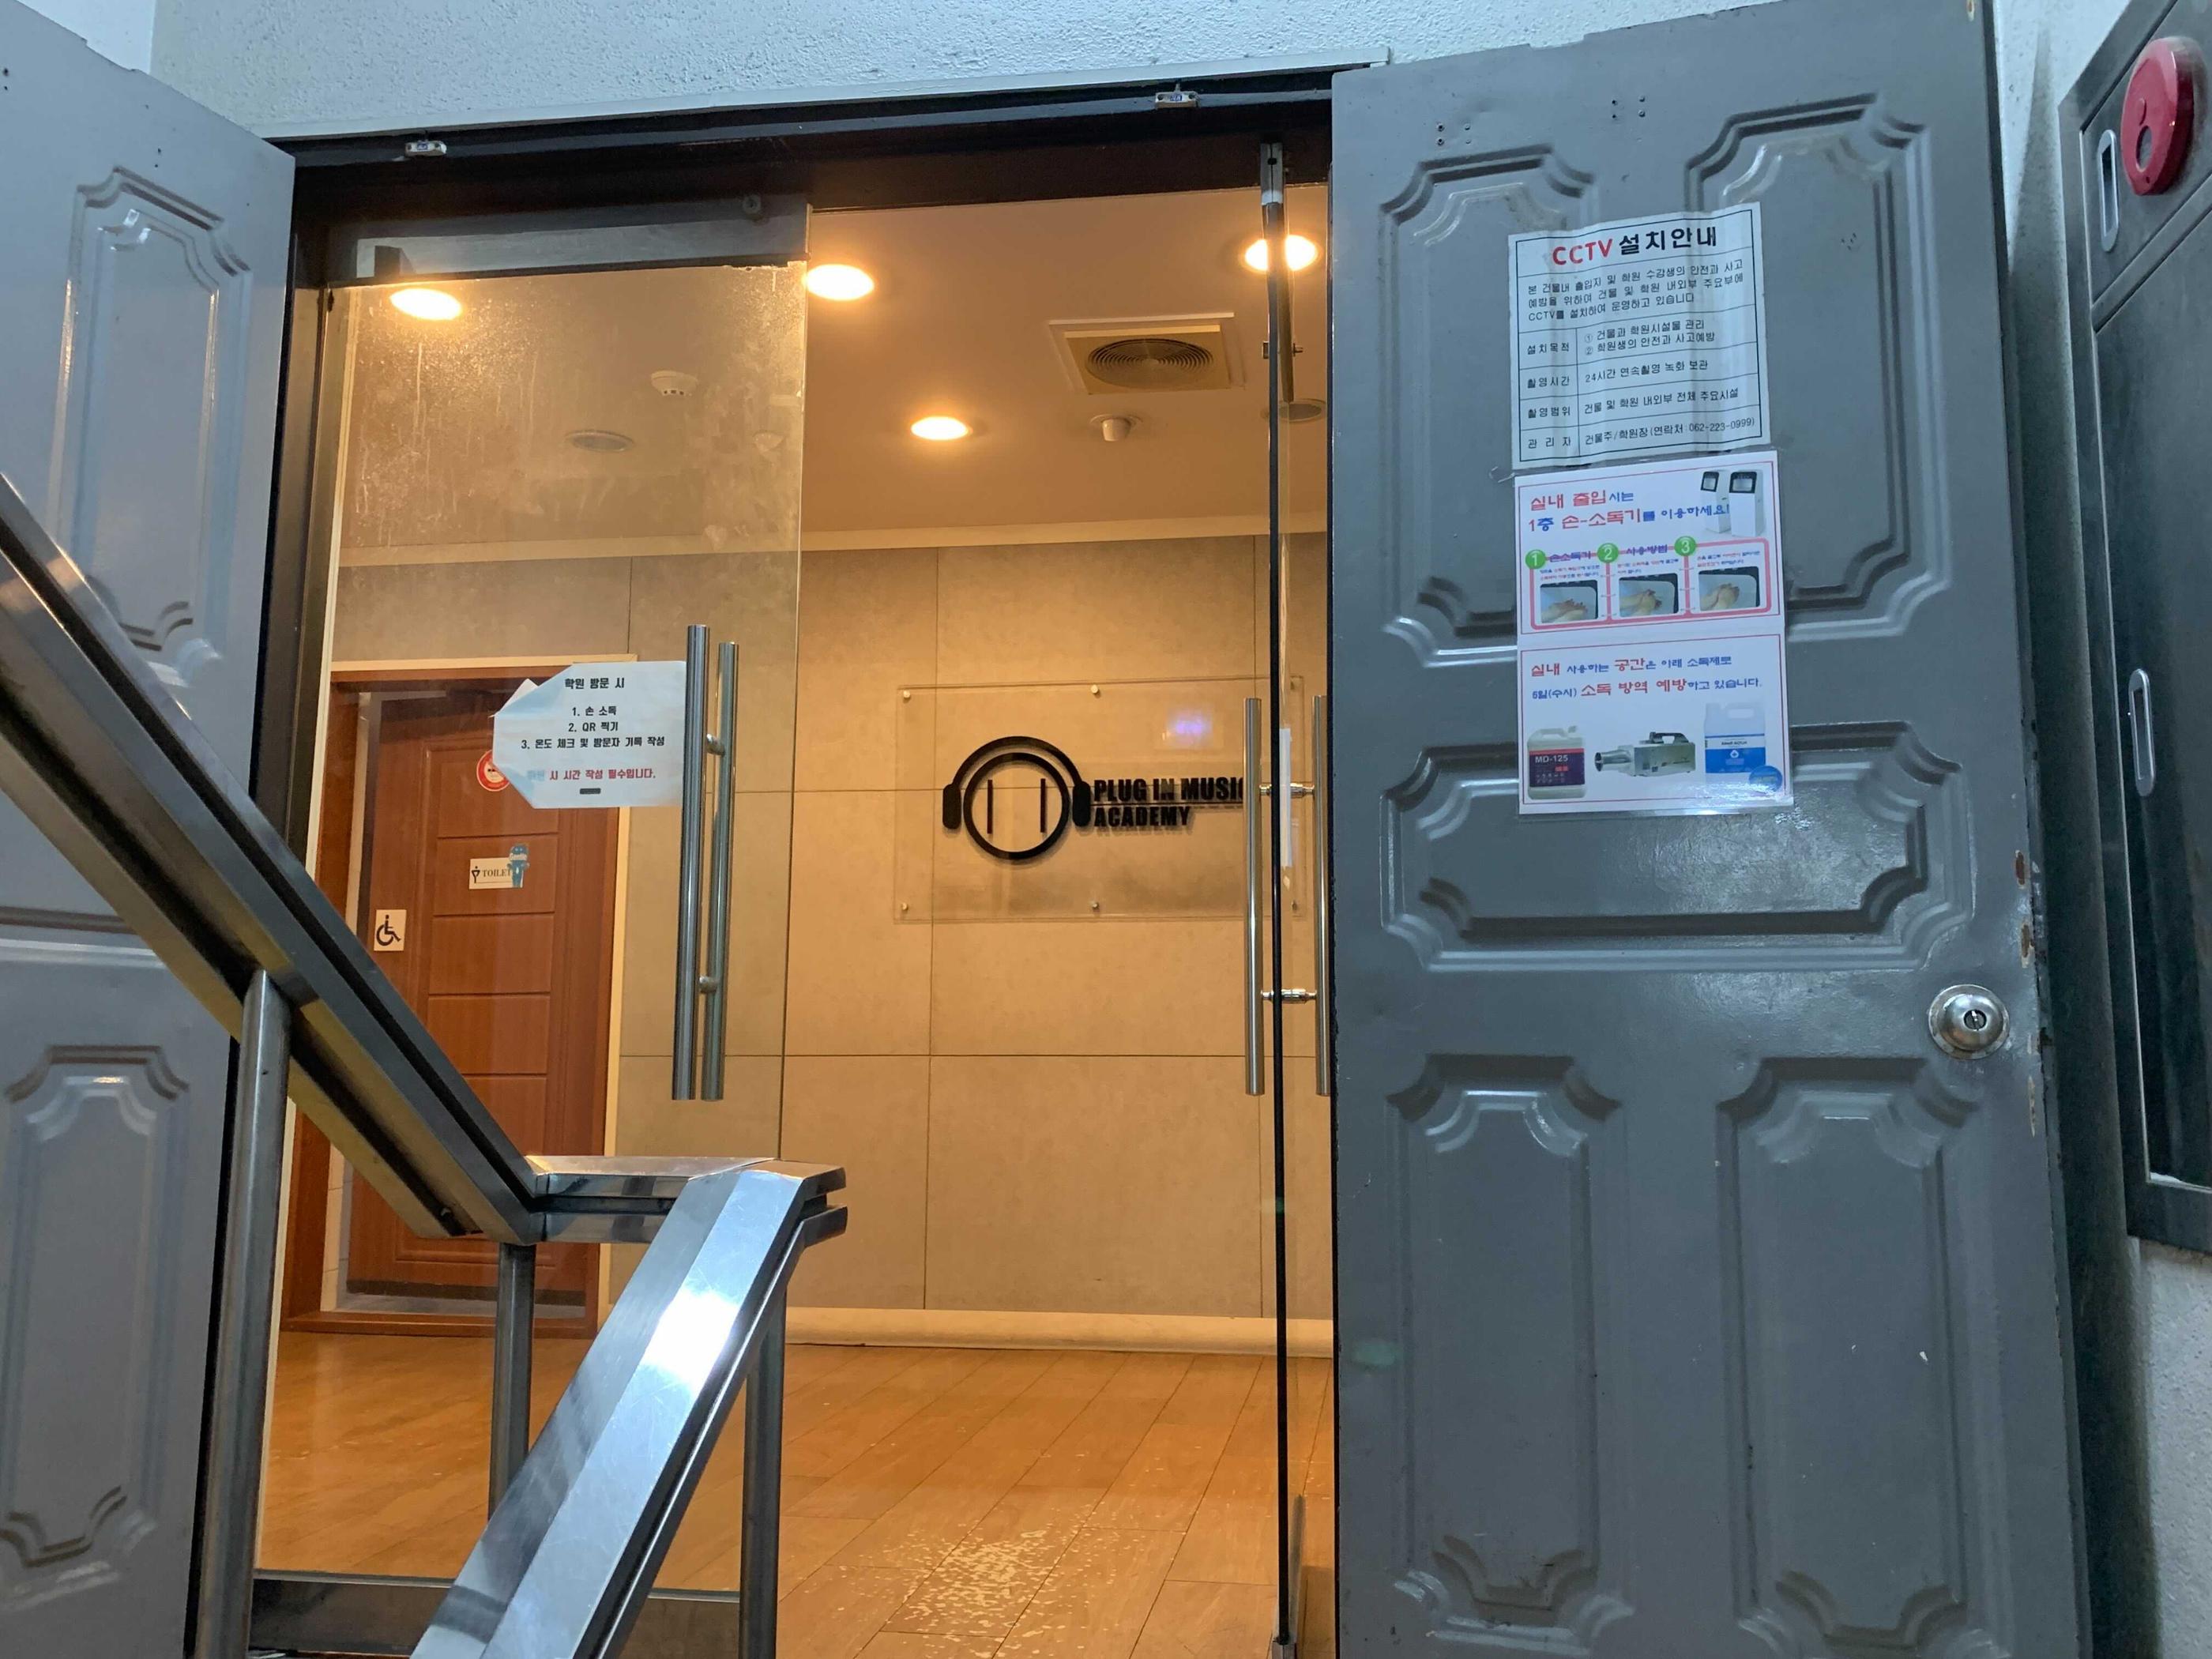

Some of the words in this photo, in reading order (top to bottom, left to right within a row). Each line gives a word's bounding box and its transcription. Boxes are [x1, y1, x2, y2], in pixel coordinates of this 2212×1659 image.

[1552, 239, 1613, 265] CCTV
[1619, 227, 1717, 255] 설치안내
[1528, 285, 1537, 295] 본
[1607, 274, 1616, 284] 및
[1622, 272, 1641, 282] 학원
[1646, 266, 1685, 279] 수강생의
[1691, 265, 1719, 276] 안전과
[1724, 259, 1743, 272] 사고
[1529, 296, 1557, 309] 예방을
[1564, 293, 1592, 307] 위하여
[1598, 288, 1617, 300] 건물
[1624, 286, 1633, 297] 및
[1640, 283, 1660, 294] 학원
[1667, 279, 1697, 291] 내외부
[1704, 273, 1744, 289] 주요부에
[1529, 310, 1564, 322] CCTV를
[1570, 303, 1606, 319] 설치하여
[1612, 298, 1650, 312] 운영하고
[1656, 292, 1695, 307] 있습니다
[1597, 327, 1626, 340] 건물과
[1630, 320, 1681, 335] 학원시설물
[1685, 319, 1705, 330] 관리
[1597, 339, 1637, 352] 학원생의
[1641, 334, 1671, 348] 안전과
[1675, 331, 1715, 343] 사고예방
[1585, 368, 1616, 383] 24시간
[1620, 363, 1661, 378] 연속촬영
[1665, 360, 1685, 372] 녹화
[1689, 359, 1708, 371] 보관
[1585, 401, 1602, 415] 건물
[1606, 400, 1616, 411] 및
[1620, 397, 1638, 408] 학원
[1643, 393, 1672, 406] 내외부
[1676, 391, 1696, 403] 전체
[1700, 387, 1739, 401] 주요시설
[1689, 417, 1755, 432] 062-223-0999)
[1531, 493, 1564, 511] 실내
[1529, 517, 1554, 532] 1층
[1531, 663, 1560, 677] 실내
[1567, 664, 1609, 674] 사용하는
[1614, 657, 1657, 672] 공간은
[1687, 656, 1732, 668] 소독제로
[564, 678, 585, 690] 학원
[590, 677, 609, 690] 방문
[615, 677, 625, 689] 시
[1580, 683, 1612, 697] 소독
[1618, 680, 1648, 694] 방역
[1656, 678, 1710, 693] 예방하고
[1714, 677, 1762, 690] 있습니다.
[572, 706, 581, 717] 1.
[585, 705, 595, 717] 손
[598, 705, 617, 717] 소독
[568, 722, 577, 732] 2.
[582, 722, 596, 732] QR
[600, 721, 619, 732] 찍기
[521, 739, 530, 750] 3.
[535, 739, 552, 750] 온도
[557, 738, 575, 749] 체크
[580, 738, 589, 748] 및
[593, 737, 621, 748] 방문자
[625, 736, 643, 747] 기록
[647, 735, 665, 747] 작성
[1535, 754, 1569, 763] MD-125
[549, 769, 559, 781] 시
[563, 769, 581, 781] 시간
[585, 769, 604, 781] 작성
[608, 768, 656, 780] 필수입니다.
[1094, 779, 1146, 803] PLUG
[1153, 777, 1175, 801] IN
[1094, 807, 1191, 827] ACADEMY
